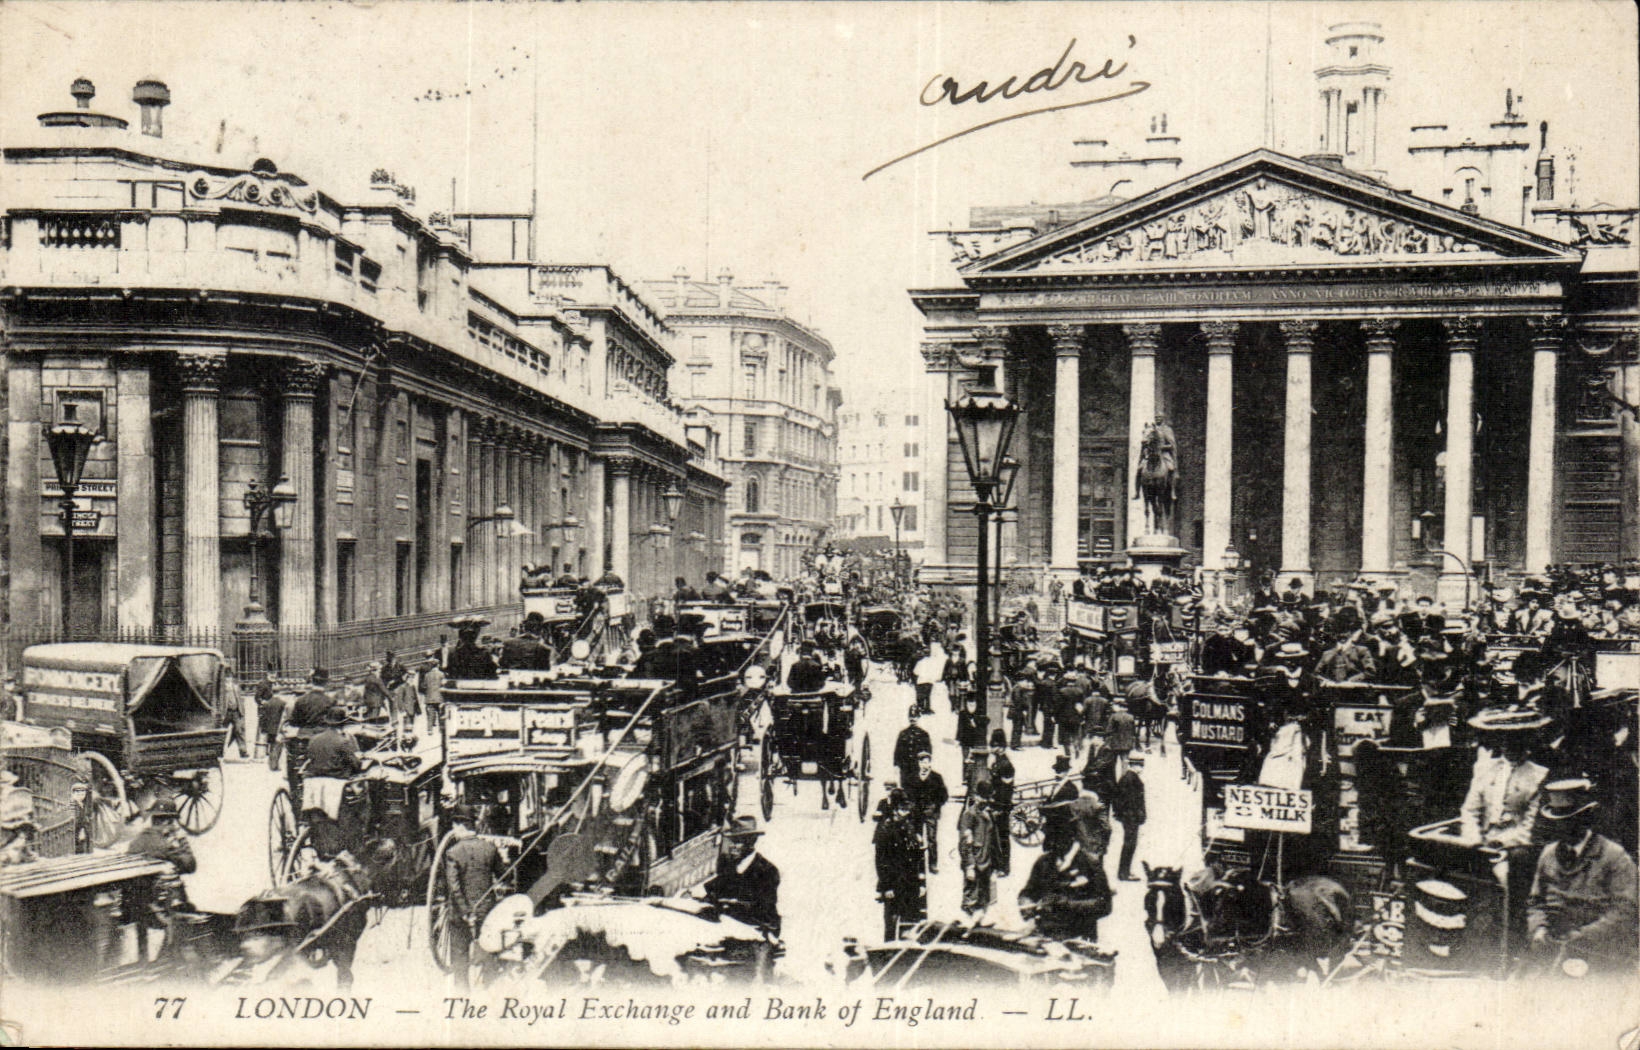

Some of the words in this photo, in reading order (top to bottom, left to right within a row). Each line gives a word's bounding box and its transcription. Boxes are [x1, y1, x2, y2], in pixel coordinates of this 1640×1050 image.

[1191, 700, 1245, 722] COLMAN'S
[1354, 712, 1384, 722] EAT
[1191, 720, 1245, 742] MUSTARD
[1261, 808, 1306, 822] MILK
